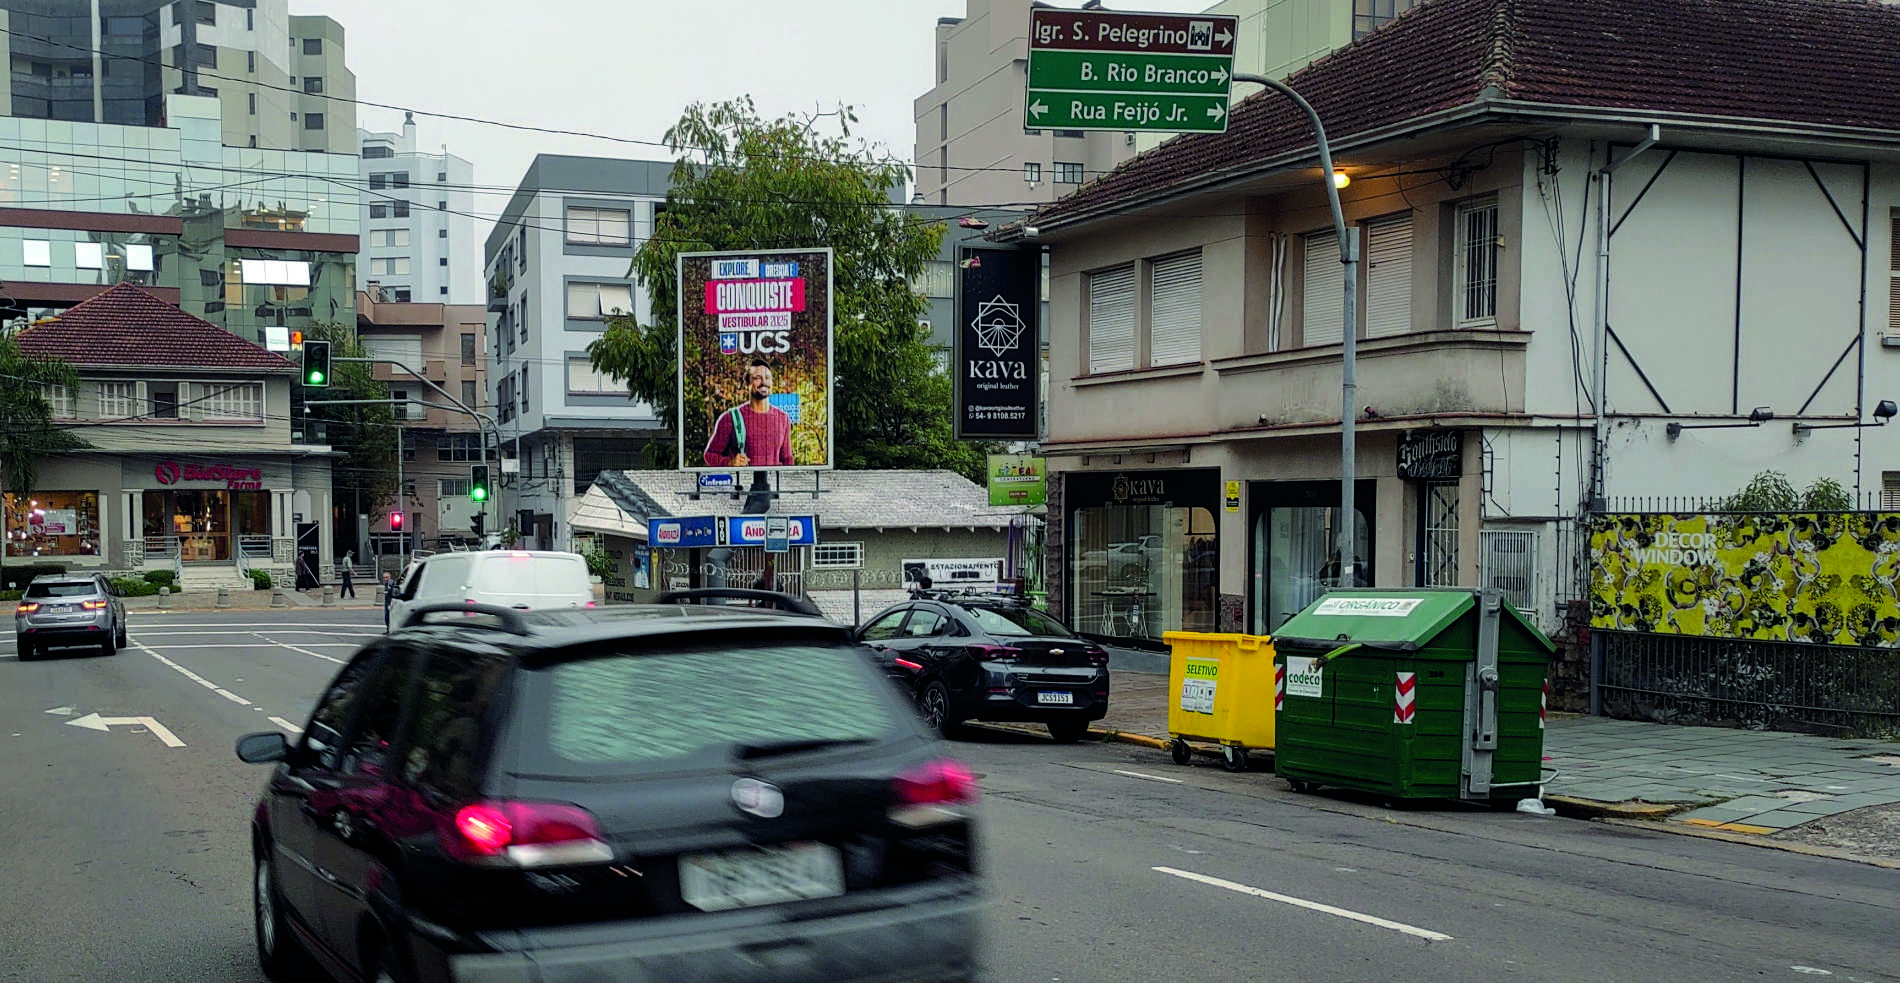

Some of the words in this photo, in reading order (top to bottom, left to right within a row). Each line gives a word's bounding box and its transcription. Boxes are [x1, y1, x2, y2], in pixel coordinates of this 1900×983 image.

[1035, 20, 1064, 44] Igr.
[1072, 21, 1090, 41] S.
[1098, 23, 1187, 48] Pelegrino
[1081, 62, 1099, 81] B.
[1107, 62, 1138, 82] Rio
[1144, 65, 1209, 84] Branco
[1071, 101, 1106, 120] Rua
[1113, 101, 1160, 124] Feijó
[1166, 103, 1188, 122] Jr.
[716, 281, 794, 311] CONQUISTE
[722, 316, 769, 328] VESTIBULAR
[739, 331, 791, 355] UCS
[976, 382, 999, 391] original
[1000, 382, 1020, 390] leather
[1631, 547, 1717, 566] WINDOW
[1186, 664, 1218, 677] SELETIVO
[1288, 670, 1321, 685] codeca
